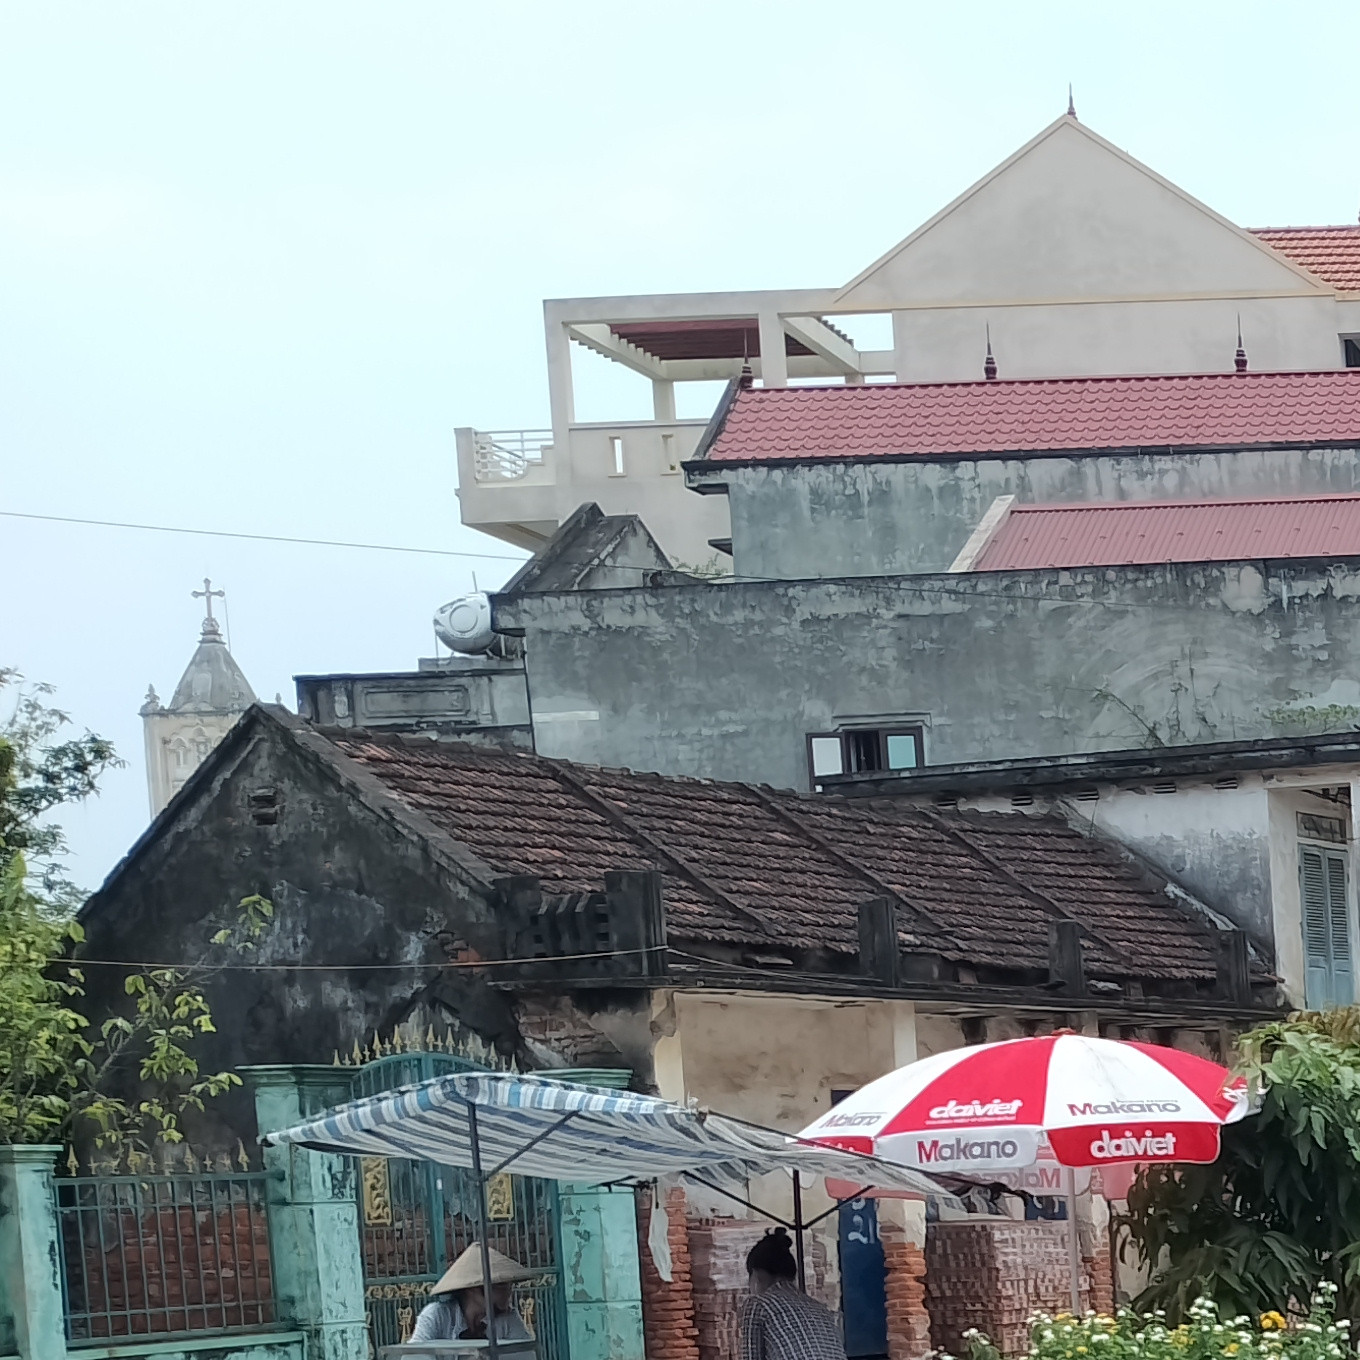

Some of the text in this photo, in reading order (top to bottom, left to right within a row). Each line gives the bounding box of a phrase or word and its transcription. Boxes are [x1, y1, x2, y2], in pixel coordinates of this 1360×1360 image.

[929, 1098, 1023, 1119] daiviet
[1066, 1099, 1181, 1117] Makano
[917, 1138, 1018, 1163] Makano
[1090, 1130, 1176, 1159] daiviet
